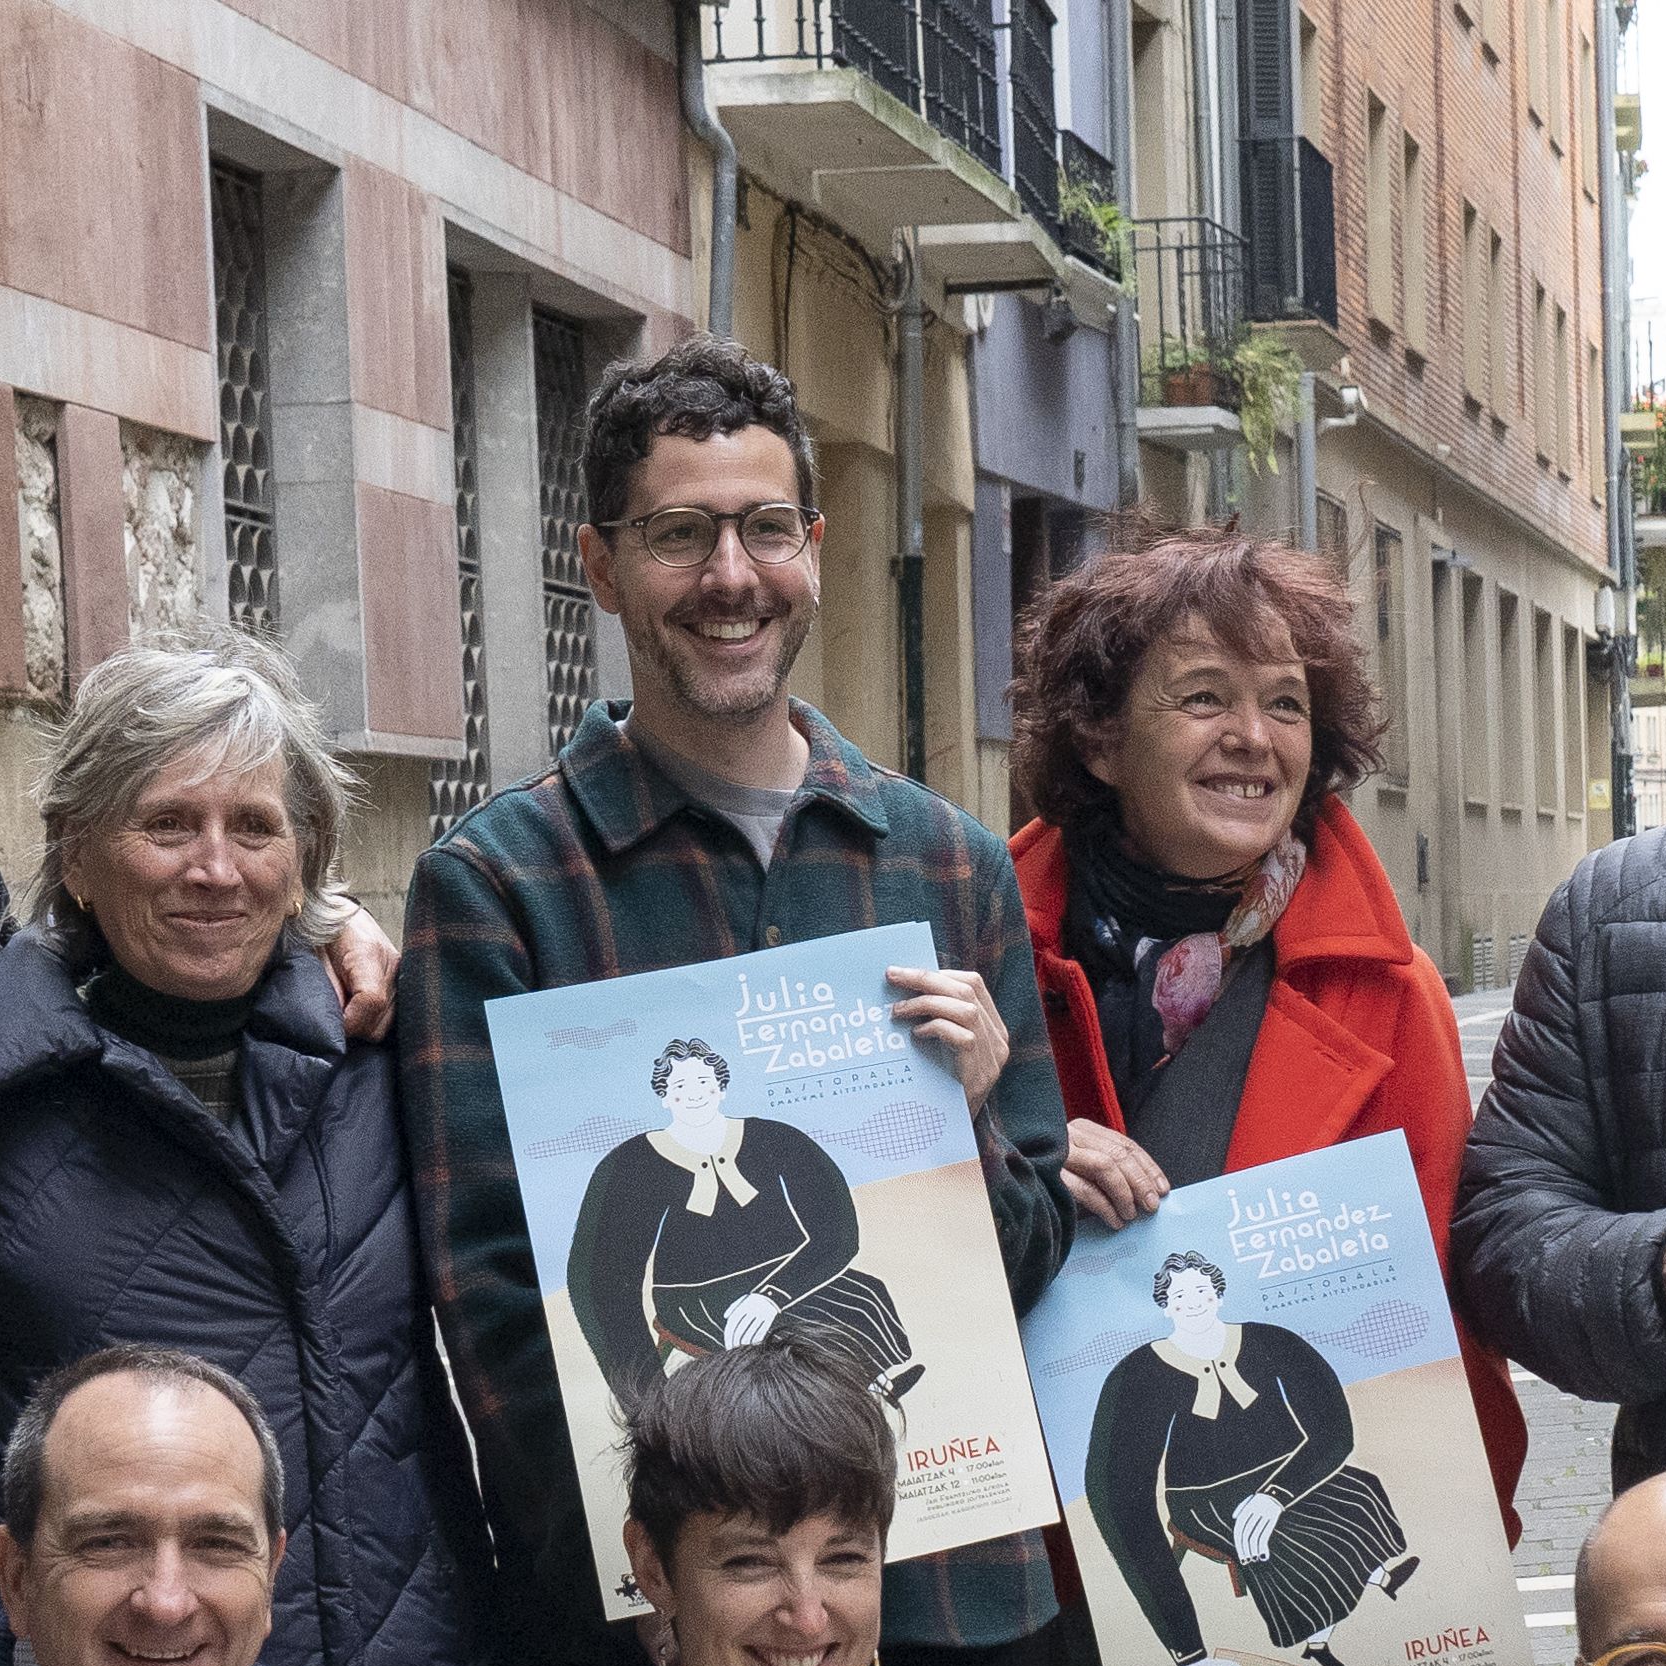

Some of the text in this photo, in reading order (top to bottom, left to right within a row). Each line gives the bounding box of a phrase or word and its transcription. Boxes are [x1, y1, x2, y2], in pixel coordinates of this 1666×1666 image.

[736, 973, 834, 1017] Julia
[743, 1026, 906, 1073] Zabaleta
[1227, 1188, 1319, 1229] Julia
[1229, 1203, 1392, 1256] Fernandez
[1237, 1229, 1389, 1279] Zabaleta
[907, 1436, 1000, 1472] IRUÑEA
[897, 1470, 947, 1489] MAIATZAK
[899, 1483, 948, 1501] MAIATZAK
[951, 1480, 961, 1489] 12
[1404, 1626, 1490, 1661] IRUÑEA
